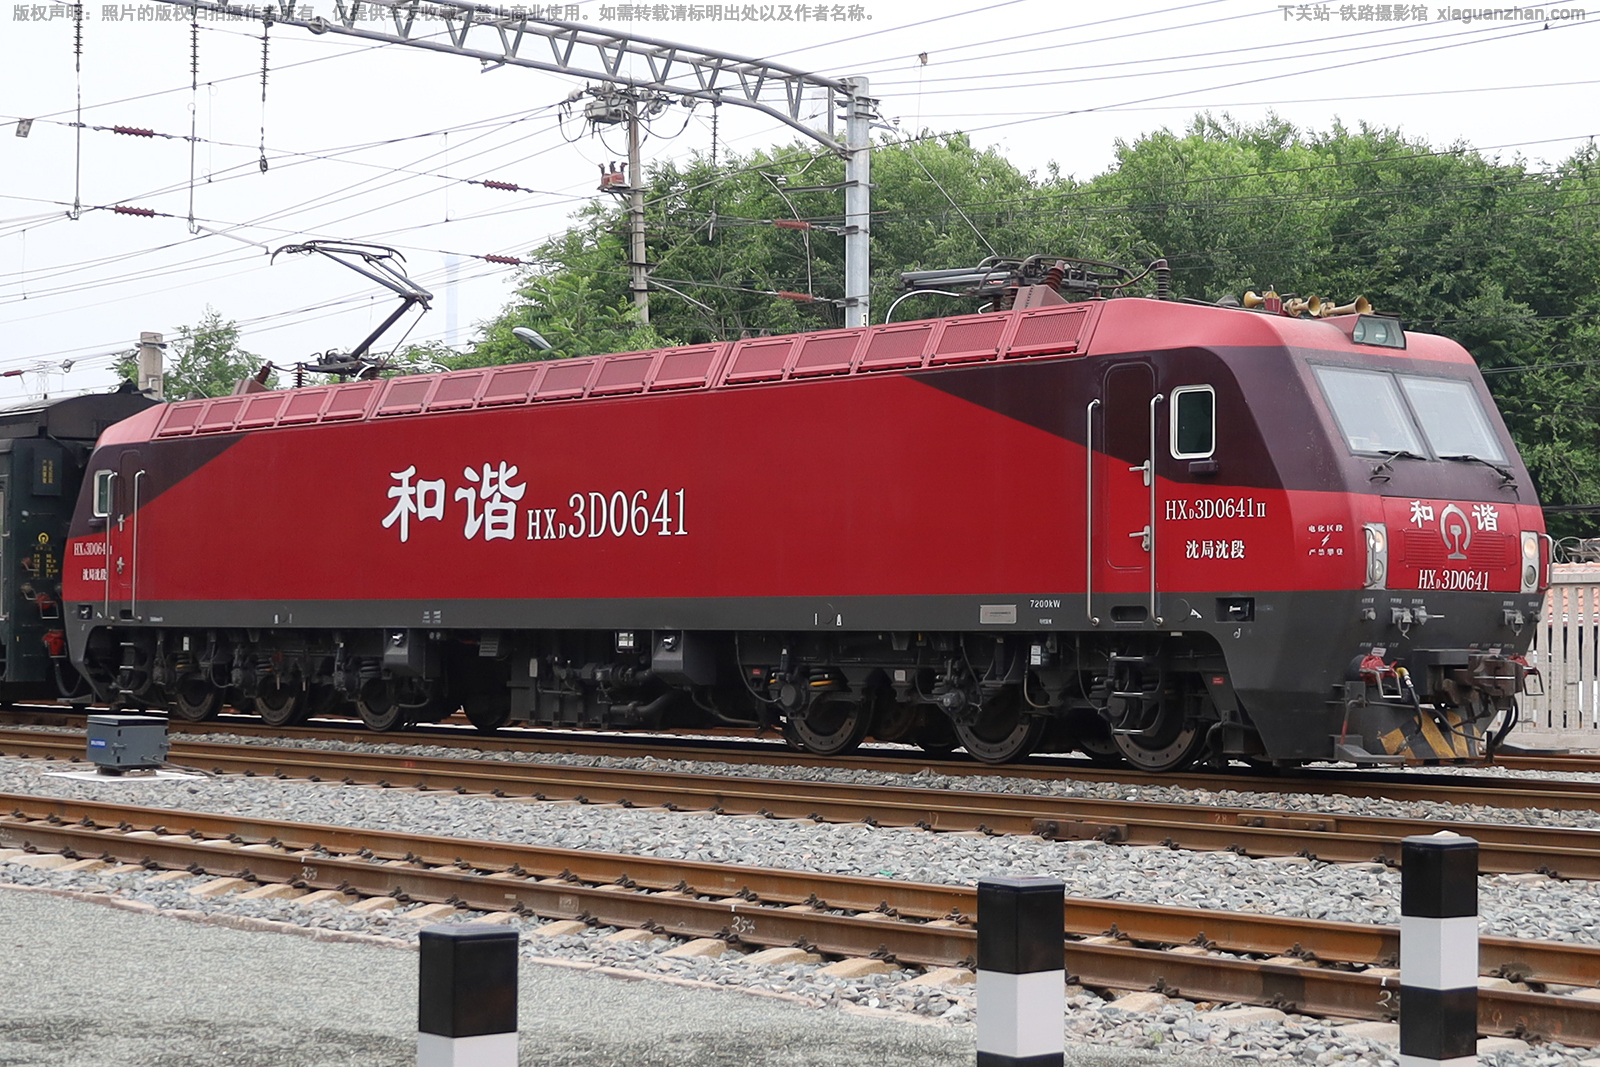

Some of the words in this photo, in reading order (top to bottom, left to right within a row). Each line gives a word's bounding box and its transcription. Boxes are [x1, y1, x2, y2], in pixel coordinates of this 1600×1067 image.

[381, 460, 527, 543] 和谐
[526, 487, 689, 541] HXD3D0641
[1185, 539, 1246, 560] 沈局沈段
[1417, 569, 1489, 591] HXD3D0641
[1029, 599, 1061, 608] 7200kW
